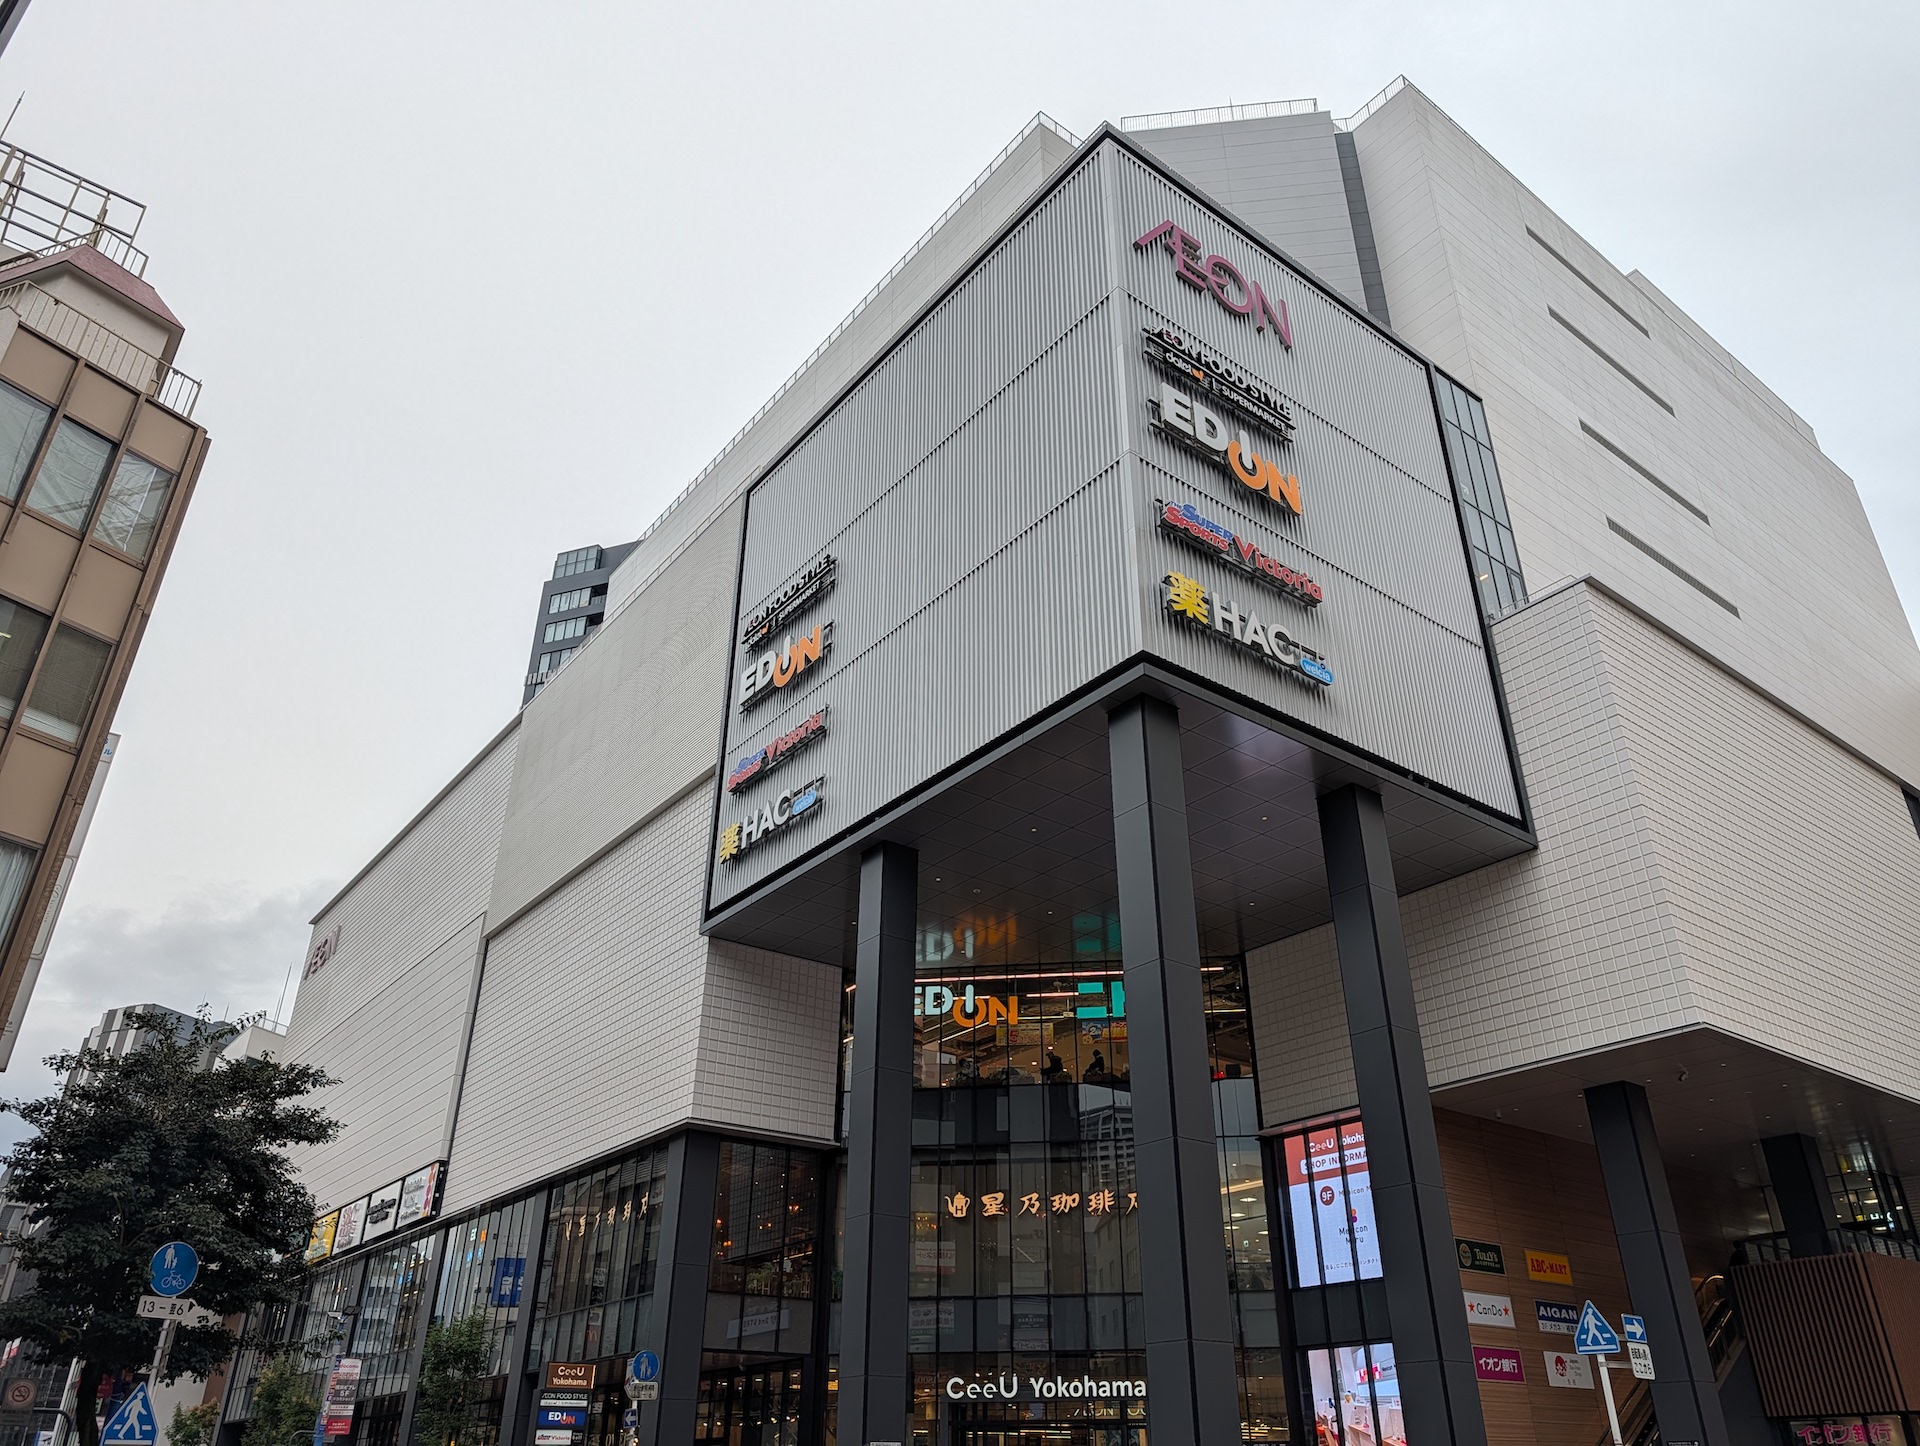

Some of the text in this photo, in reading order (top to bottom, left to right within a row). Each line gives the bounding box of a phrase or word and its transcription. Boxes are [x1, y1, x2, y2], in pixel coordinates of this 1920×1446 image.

[1201, 351, 1249, 389] FOOD
[1249, 380, 1293, 418] STYLE
[1221, 385, 1286, 431] SUPERMARKET
[1161, 382, 1303, 516] EDION
[1165, 506, 1229, 551] SPORTS
[1181, 503, 1234, 543] SUPER
[768, 581, 797, 612] FOOD
[798, 556, 831, 589] STYLE
[1234, 534, 1323, 601] Victoria
[1168, 571, 1294, 665] 薬 HAC
[740, 624, 822, 704] EDION
[1303, 661, 1332, 681] welcia
[766, 712, 823, 761] Victoria
[741, 789, 792, 849] HAC
[1321, 1190, 1333, 1202] 9F
[1530, 1258, 1567, 1275] ABC-MART
[1476, 1300, 1503, 1316] CanDo
[1539, 1306, 1578, 1321] AIGAN
[552, 1377, 587, 1386] Yokohama
[1478, 1356, 1518, 1374] イオン銀行
[556, 1392, 572, 1400] FOOD
[573, 1392, 588, 1400] STYLE
[946, 1375, 1147, 1399] CeeU Yokohama
[548, 1411, 575, 1425] EDION
